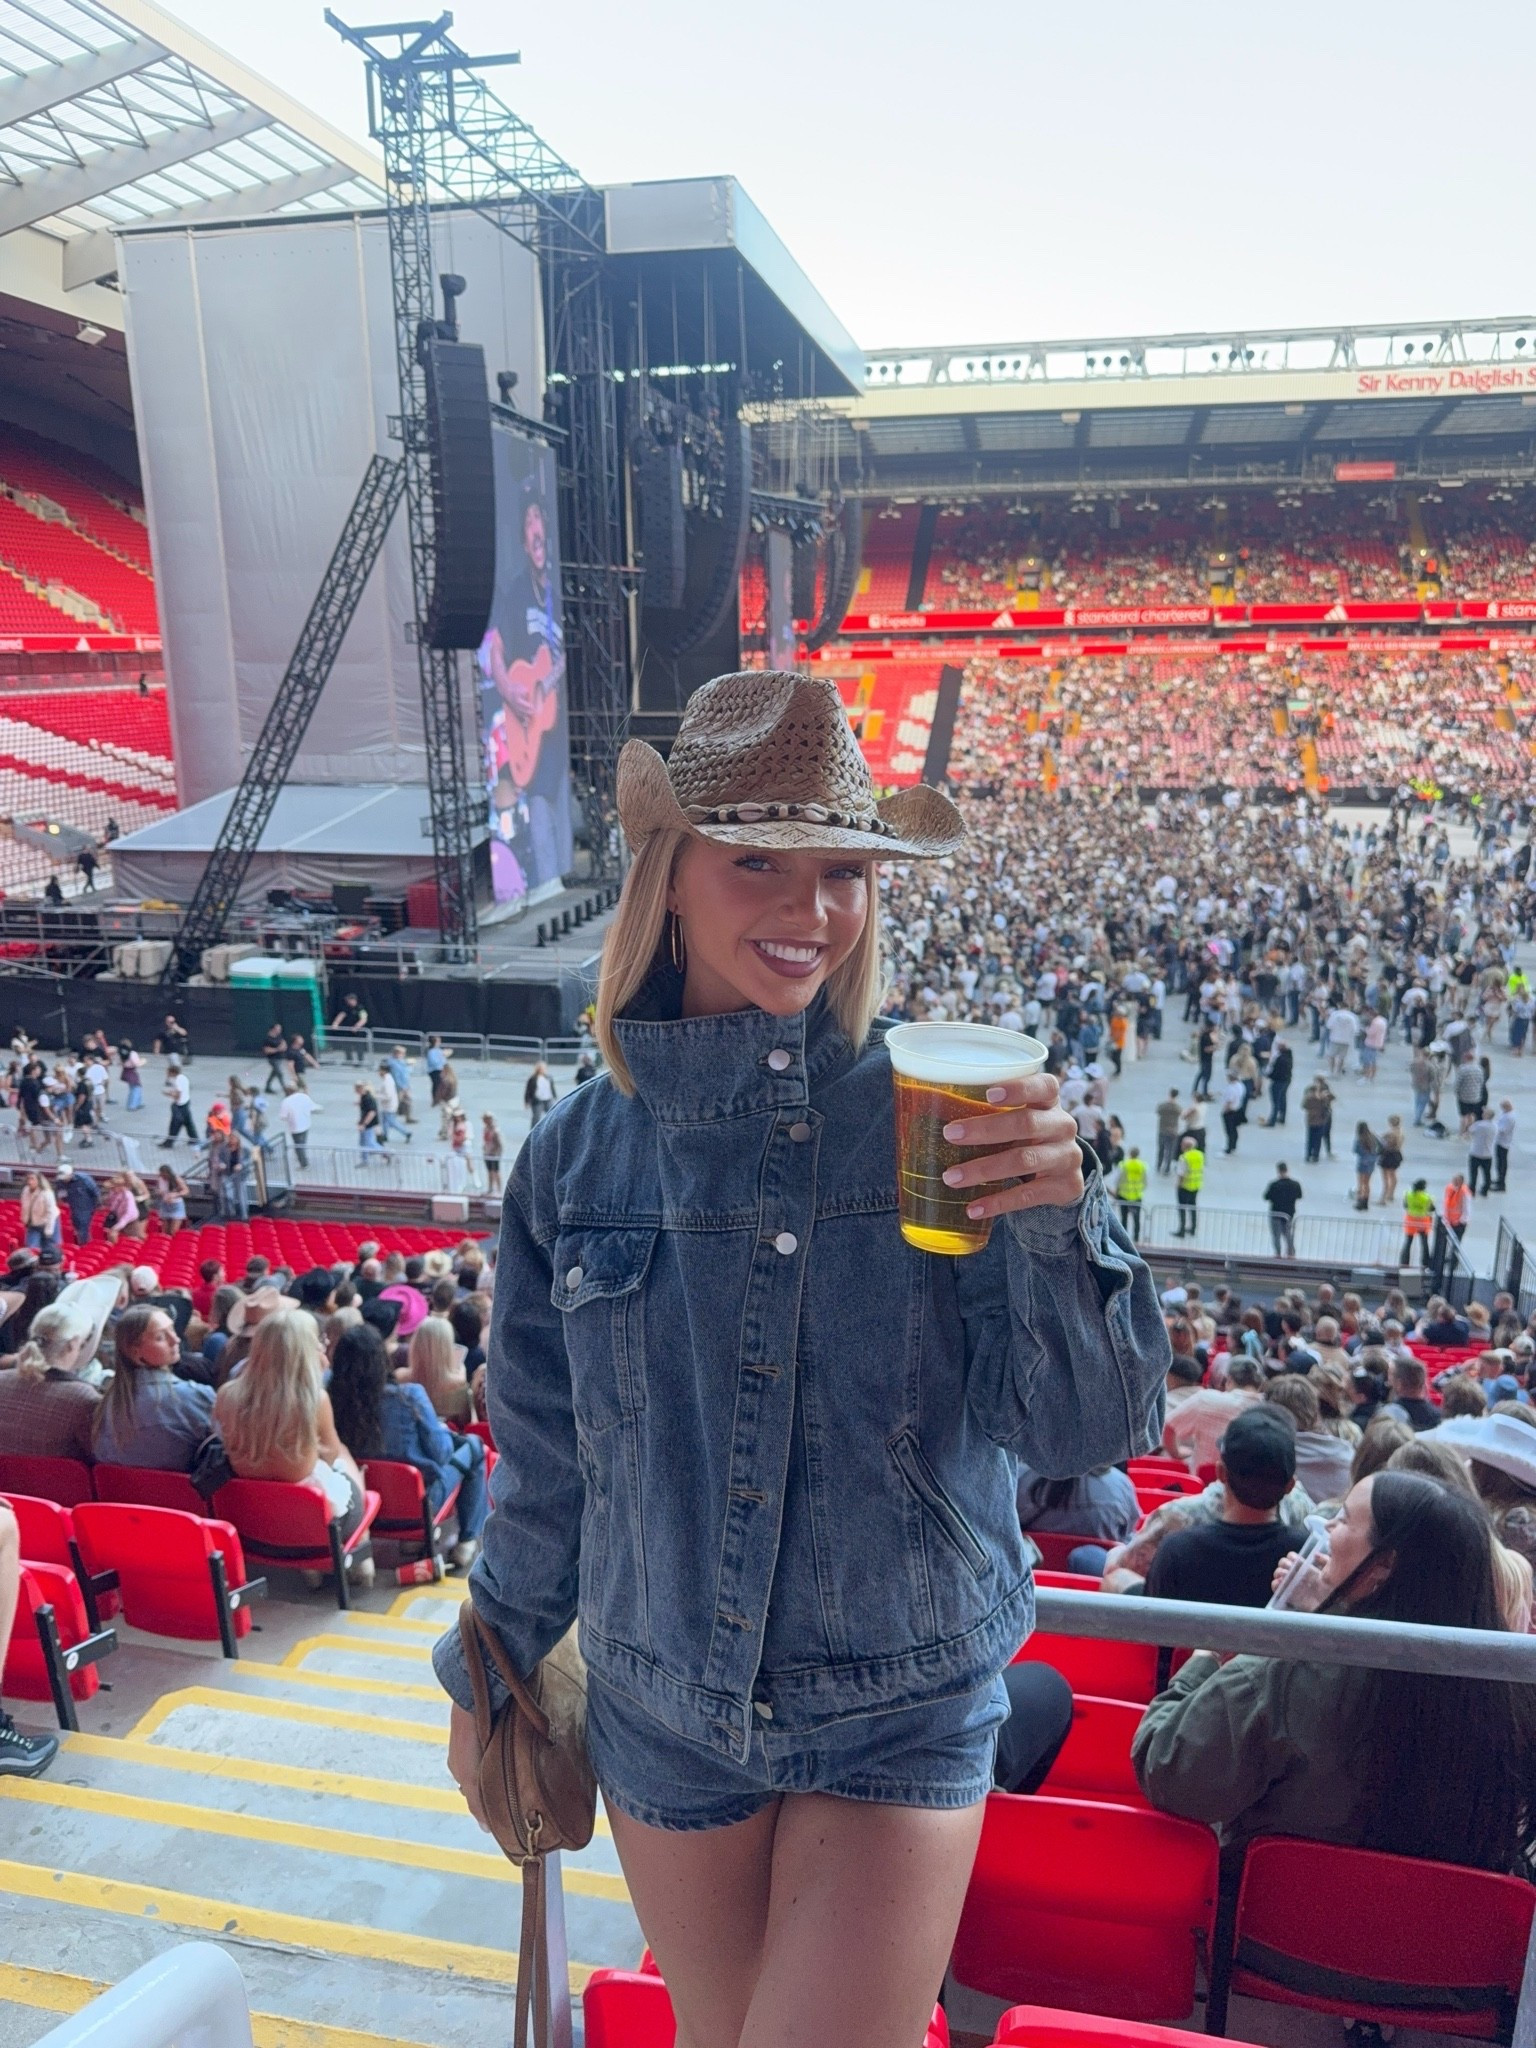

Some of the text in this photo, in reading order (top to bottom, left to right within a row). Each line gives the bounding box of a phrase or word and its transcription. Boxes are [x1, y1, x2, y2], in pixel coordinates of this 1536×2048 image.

[1358, 375, 1382, 393] Sir
[1386, 373, 1443, 395] Kenny
[1449, 368, 1523, 394] Dalglish
[1077, 608, 1209, 624] standard chartered
[1501, 603, 1536, 617] stan
